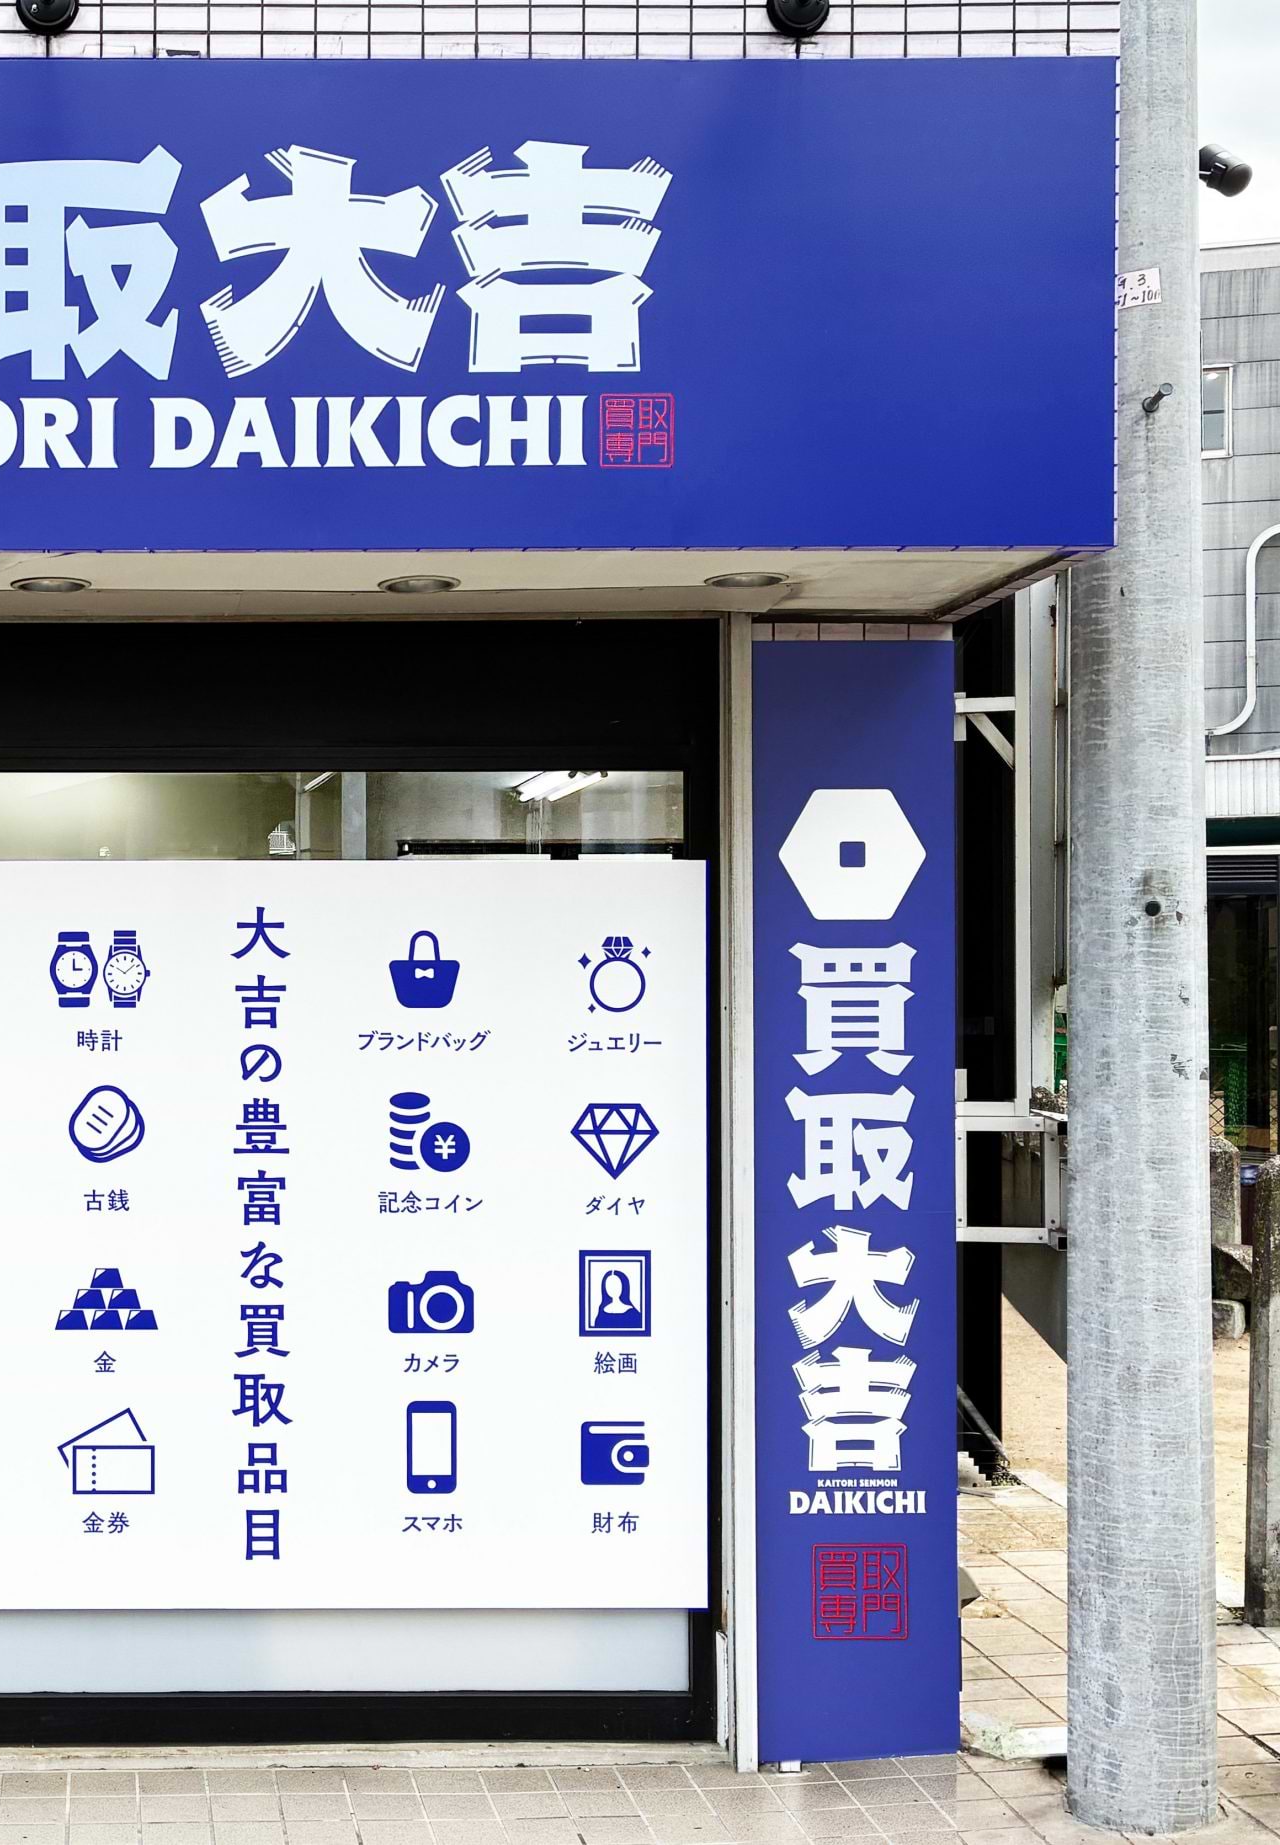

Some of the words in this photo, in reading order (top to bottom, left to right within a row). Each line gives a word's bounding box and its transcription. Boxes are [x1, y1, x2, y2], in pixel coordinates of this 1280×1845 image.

[149, 394, 588, 470] DAIKICHI
[77, 1028, 123, 1052] 時計
[358, 1029, 492, 1052] ブランドバッグ
[567, 1032, 662, 1054] ジュエリー
[83, 1188, 130, 1212] 古銭
[377, 1190, 483, 1214] 記念コイン
[585, 1195, 646, 1216] ダイヤ
[784, 941, 920, 1472] 買取大吉
[230, 906, 293, 1562] 大吉の豊富な買取品目
[93, 1350, 117, 1373] 金
[403, 1352, 460, 1373] カメラ
[593, 1351, 637, 1375] 絵画
[817, 1478, 858, 1488] KAITORI
[859, 1478, 898, 1488] SENMON
[789, 1490, 927, 1515] DAIKICHI
[82, 1511, 130, 1534] 金券
[401, 1513, 463, 1533] スマホ
[591, 1511, 640, 1534] 財布
